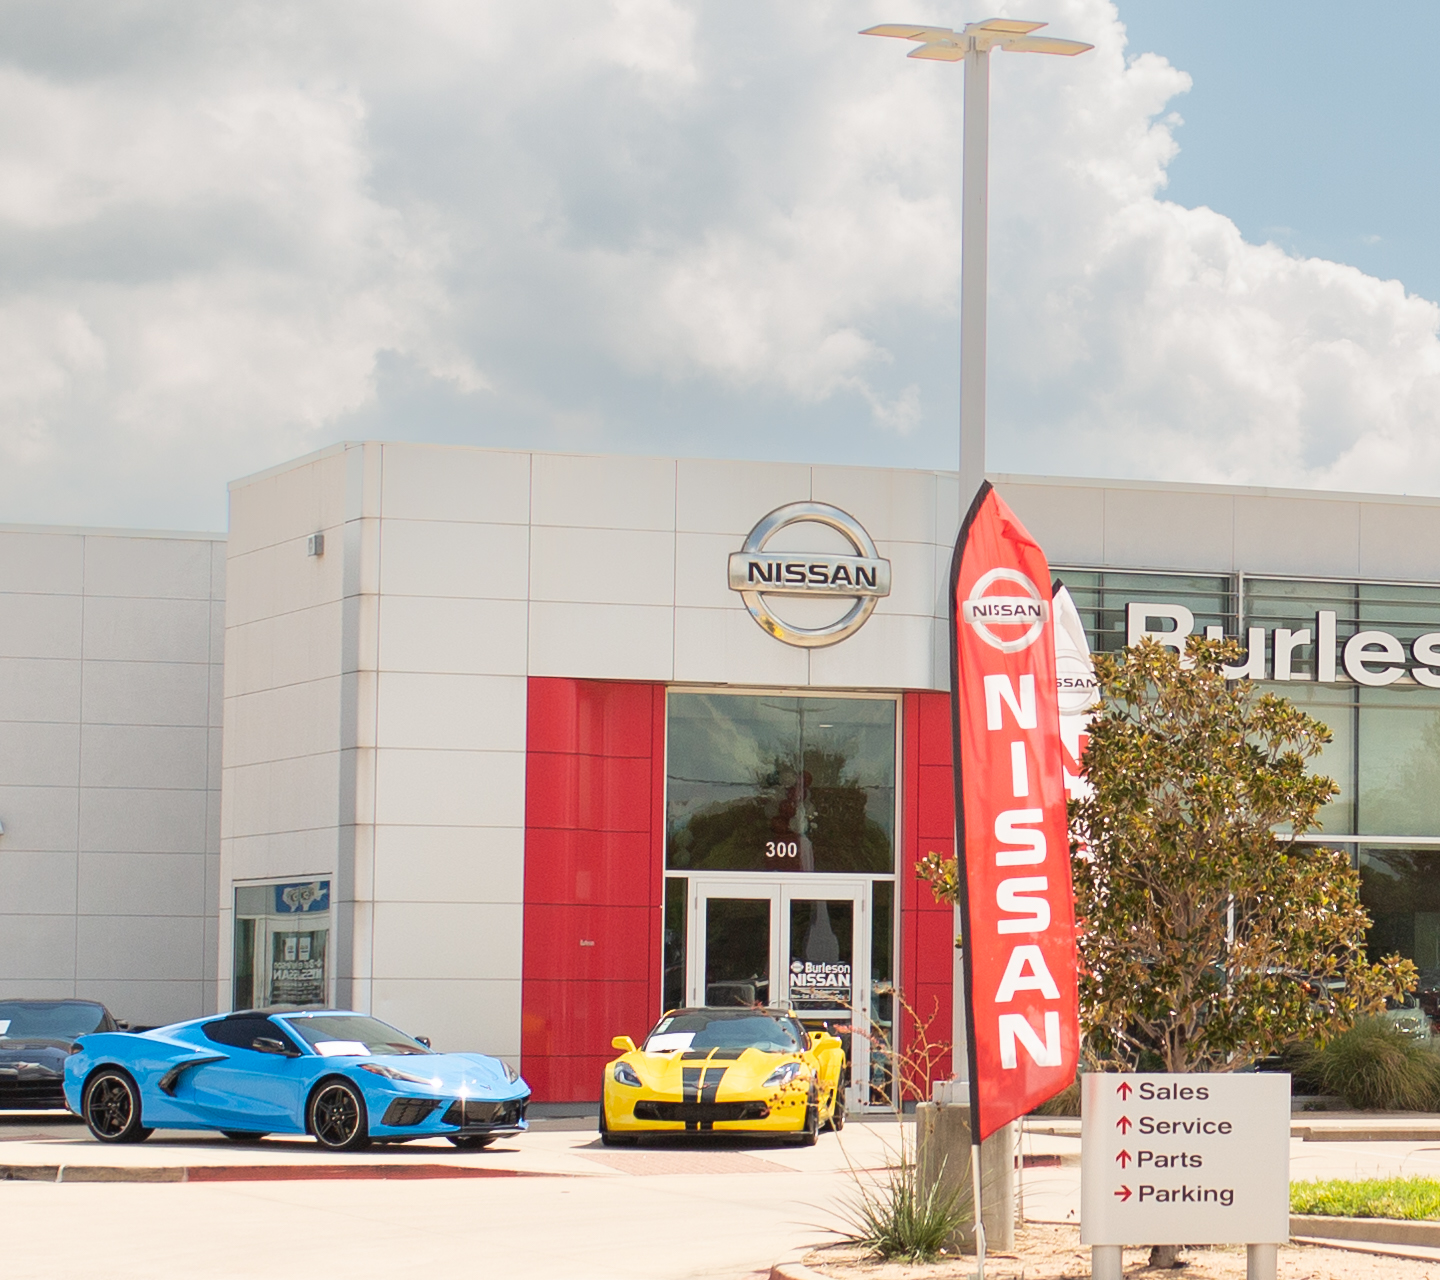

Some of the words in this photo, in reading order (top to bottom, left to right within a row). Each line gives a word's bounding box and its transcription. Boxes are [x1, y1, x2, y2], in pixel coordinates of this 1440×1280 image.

[747, 561, 877, 588] NISSAN
[971, 603, 1042, 618] NISSAN
[765, 841, 797, 858] 300
[985, 673, 1062, 1071] NISSAN
[805, 961, 850, 973] Burleson
[790, 973, 850, 987] NISSAN
[1138, 1082, 1210, 1101] Sales
[1138, 1116, 1233, 1135] Service
[1137, 1150, 1203, 1168] Parts
[1138, 1185, 1234, 1207] Parking
